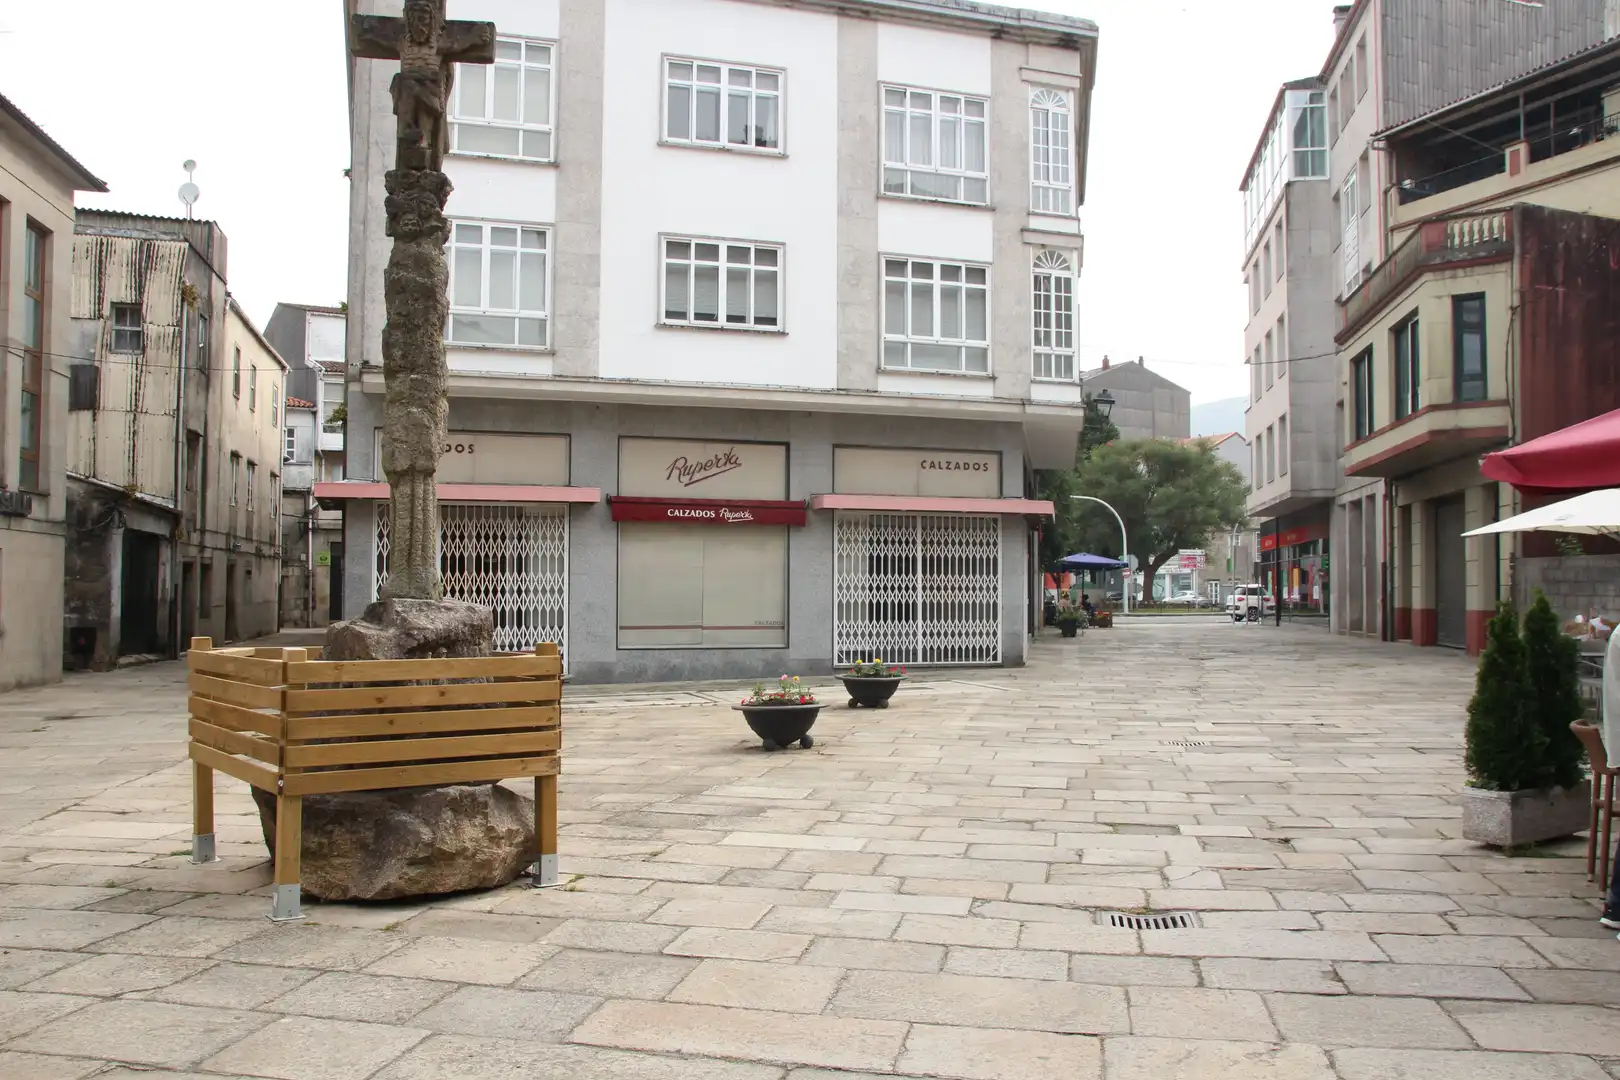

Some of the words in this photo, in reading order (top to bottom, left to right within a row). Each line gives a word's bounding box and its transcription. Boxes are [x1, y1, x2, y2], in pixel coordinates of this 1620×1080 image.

[665, 446, 742, 487] Ruperta
[920, 459, 989, 472] CALZADOS
[667, 508, 716, 518] CALZADOS
